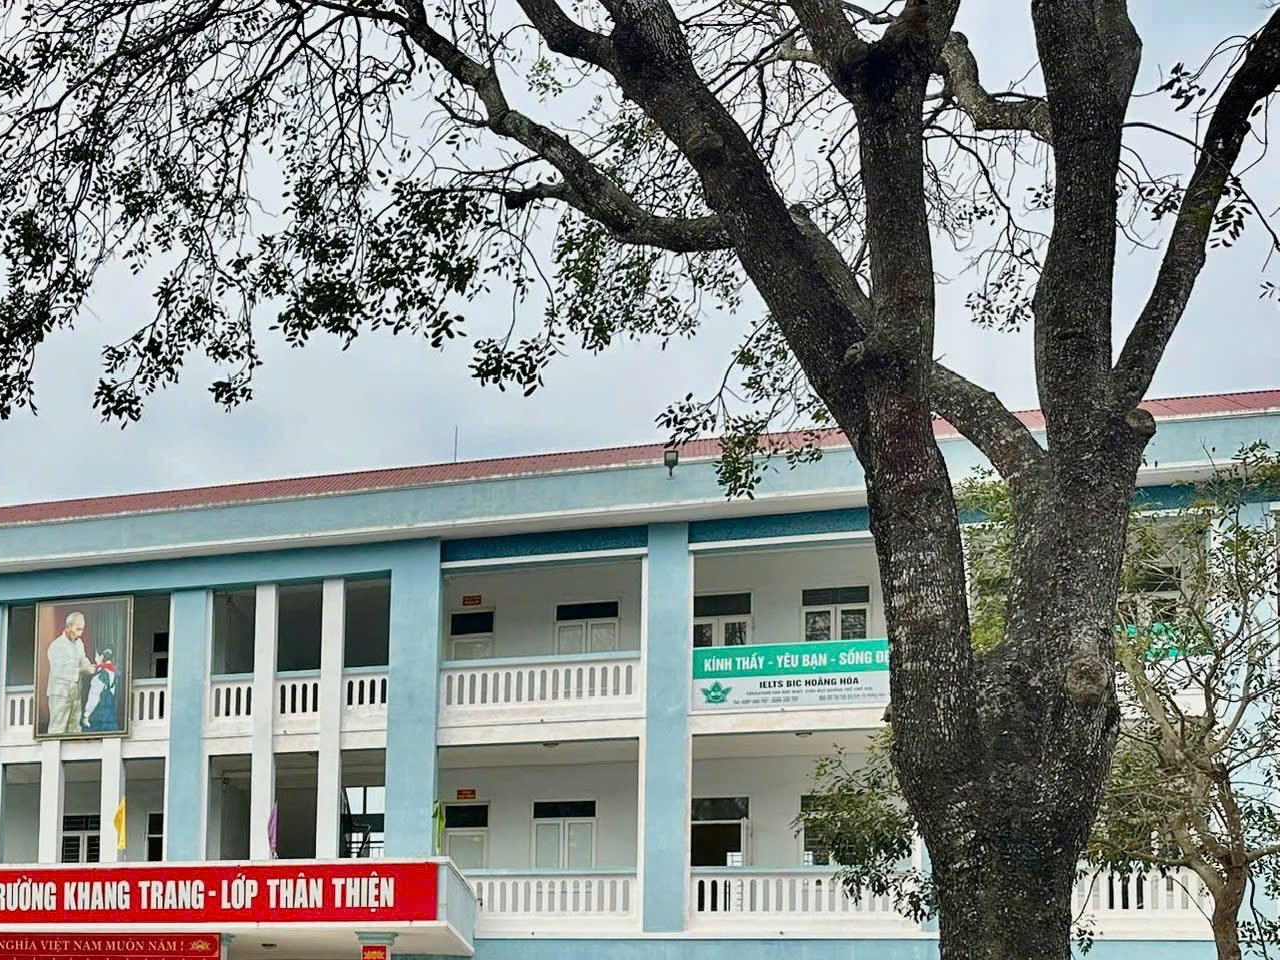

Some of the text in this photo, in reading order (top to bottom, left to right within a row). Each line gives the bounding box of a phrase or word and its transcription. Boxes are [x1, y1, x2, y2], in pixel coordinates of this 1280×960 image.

[704, 656, 732, 671] KÍNH
[736, 653, 764, 669] THẦY
[777, 653, 799, 668] YÊU
[802, 653, 827, 669] BẠN
[839, 648, 871, 665] SỐNG
[760, 680, 783, 688] IELTS
[64, 880, 131, 910] KHANG
[138, 879, 204, 910] TRANG
[222, 873, 258, 910] LỚP
[267, 874, 323, 908] THÂN
[332, 871, 395, 912] THIỆN
[41, 938, 70, 952] VIỆT
[72, 941, 102, 950] NAM
[105, 938, 139, 950] MUÔN
[148, 939, 176, 951] NĂM
